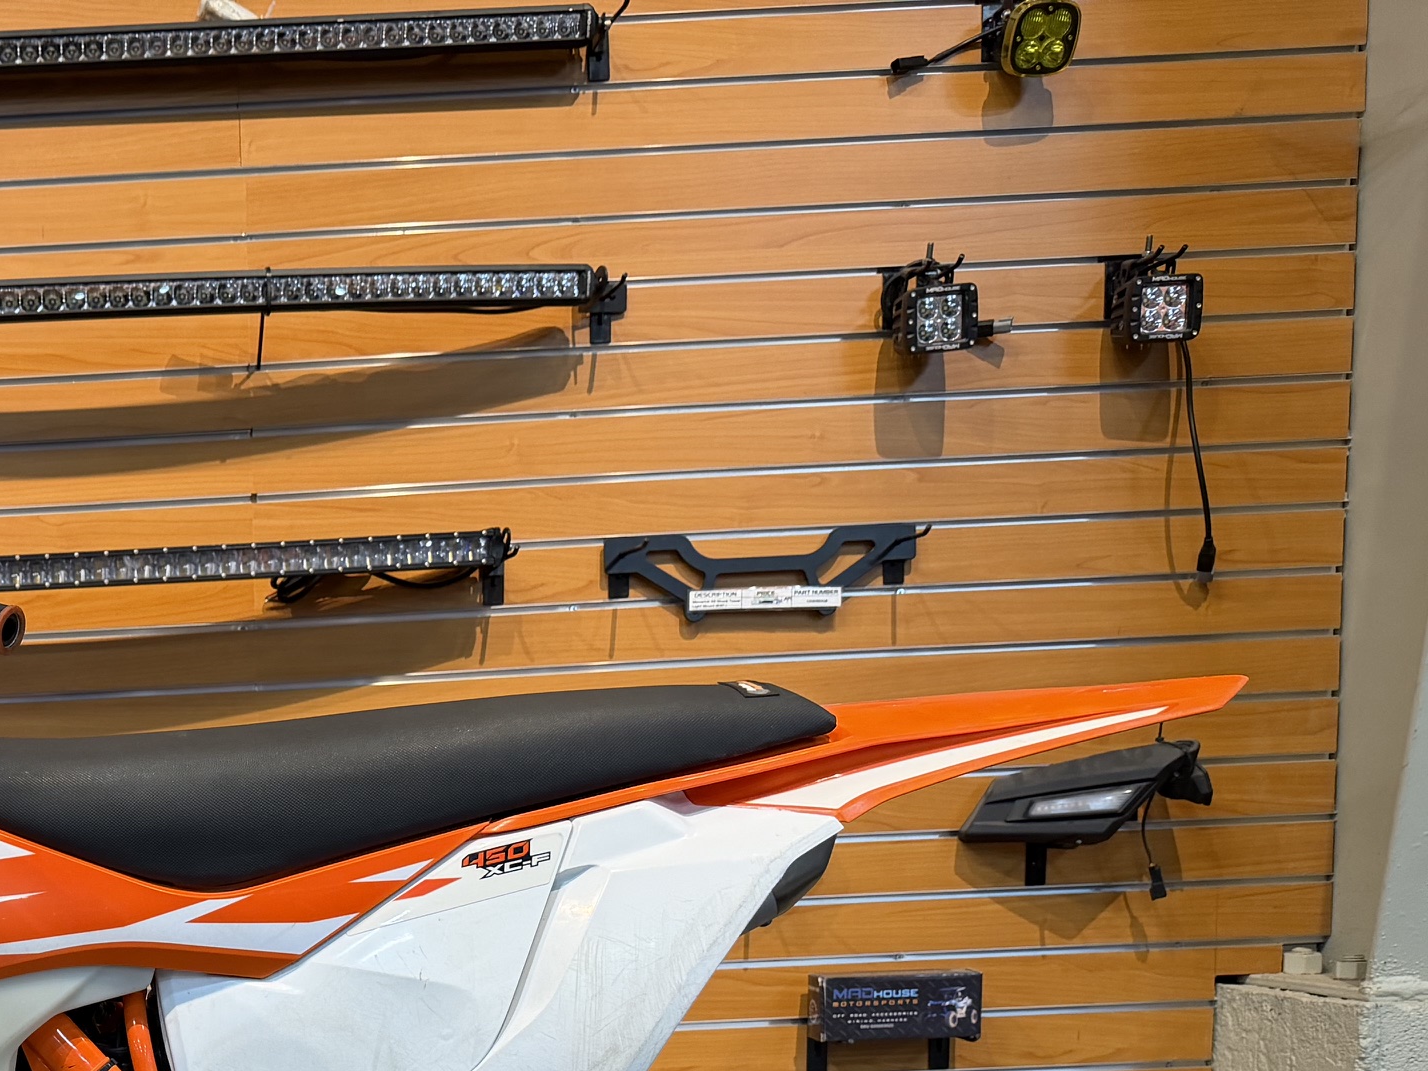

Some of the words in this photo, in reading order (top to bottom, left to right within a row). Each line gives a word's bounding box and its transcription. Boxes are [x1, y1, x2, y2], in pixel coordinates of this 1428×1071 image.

[461, 838, 532, 868] 450
[479, 851, 551, 880] XC-F
[832, 999, 919, 1008] MOTORSPORTS
